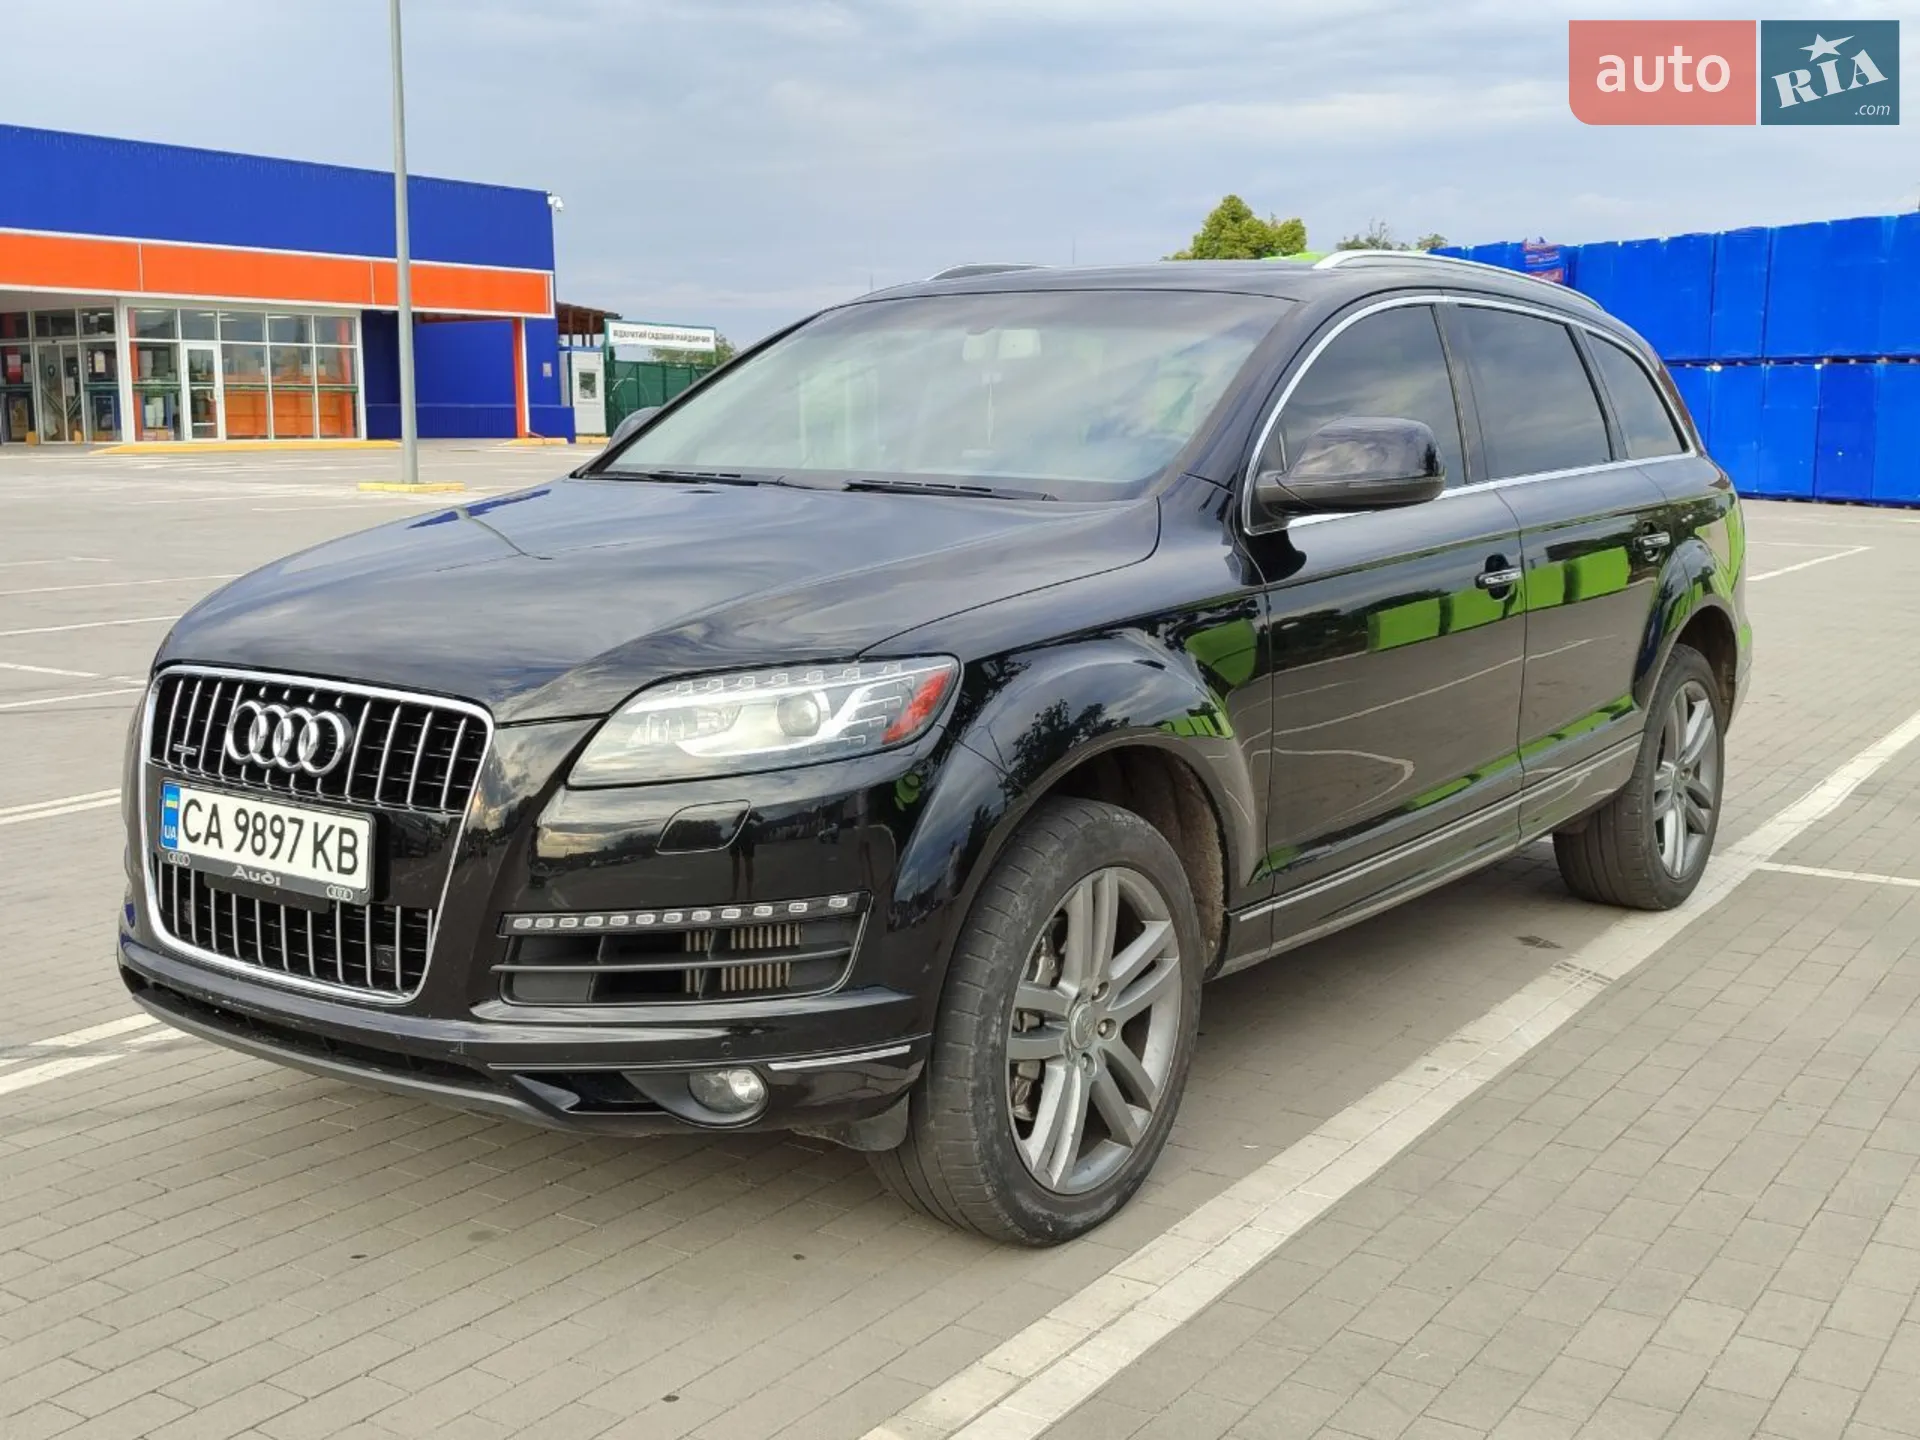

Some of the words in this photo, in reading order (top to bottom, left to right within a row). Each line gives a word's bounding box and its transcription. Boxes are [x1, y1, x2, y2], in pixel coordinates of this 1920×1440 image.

[164, 824, 177, 840] UA
[182, 799, 224, 849] CA
[234, 808, 304, 863] 9897
[312, 822, 358, 875] KB
[232, 865, 281, 886] Audi
